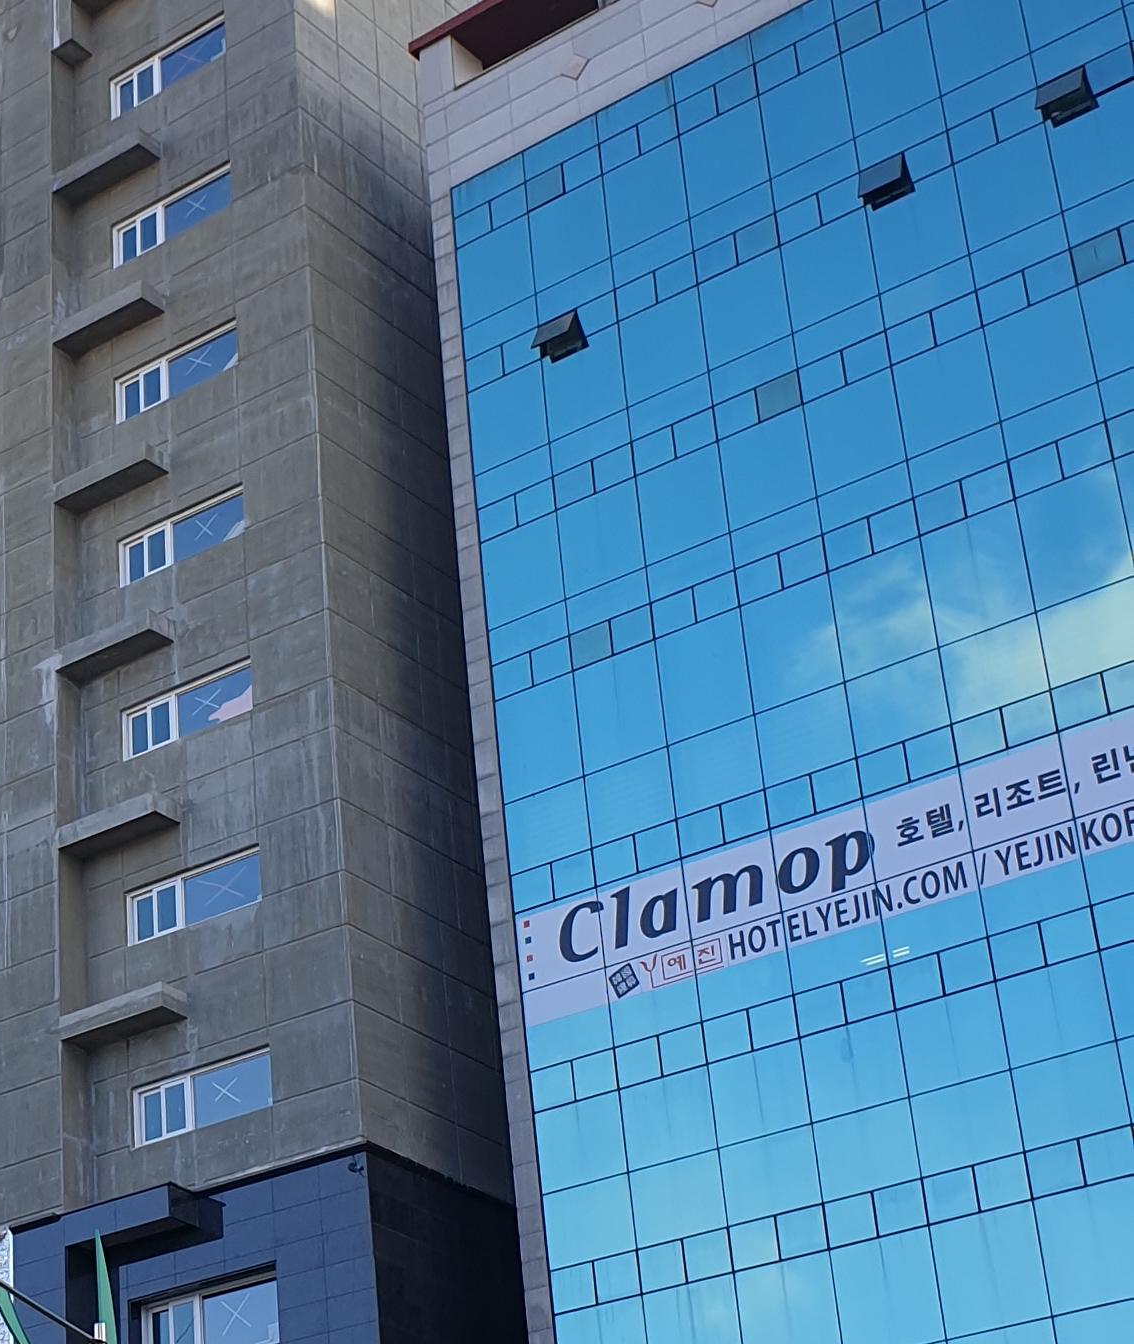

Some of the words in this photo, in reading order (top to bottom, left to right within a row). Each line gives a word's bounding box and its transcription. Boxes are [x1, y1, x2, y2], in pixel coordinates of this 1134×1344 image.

[896, 803, 964, 847] 호텔,
[973, 768, 1080, 818] 리조트,
[559, 828, 876, 963] Clamop
[728, 861, 968, 960] HOTELYEJIN.COM
